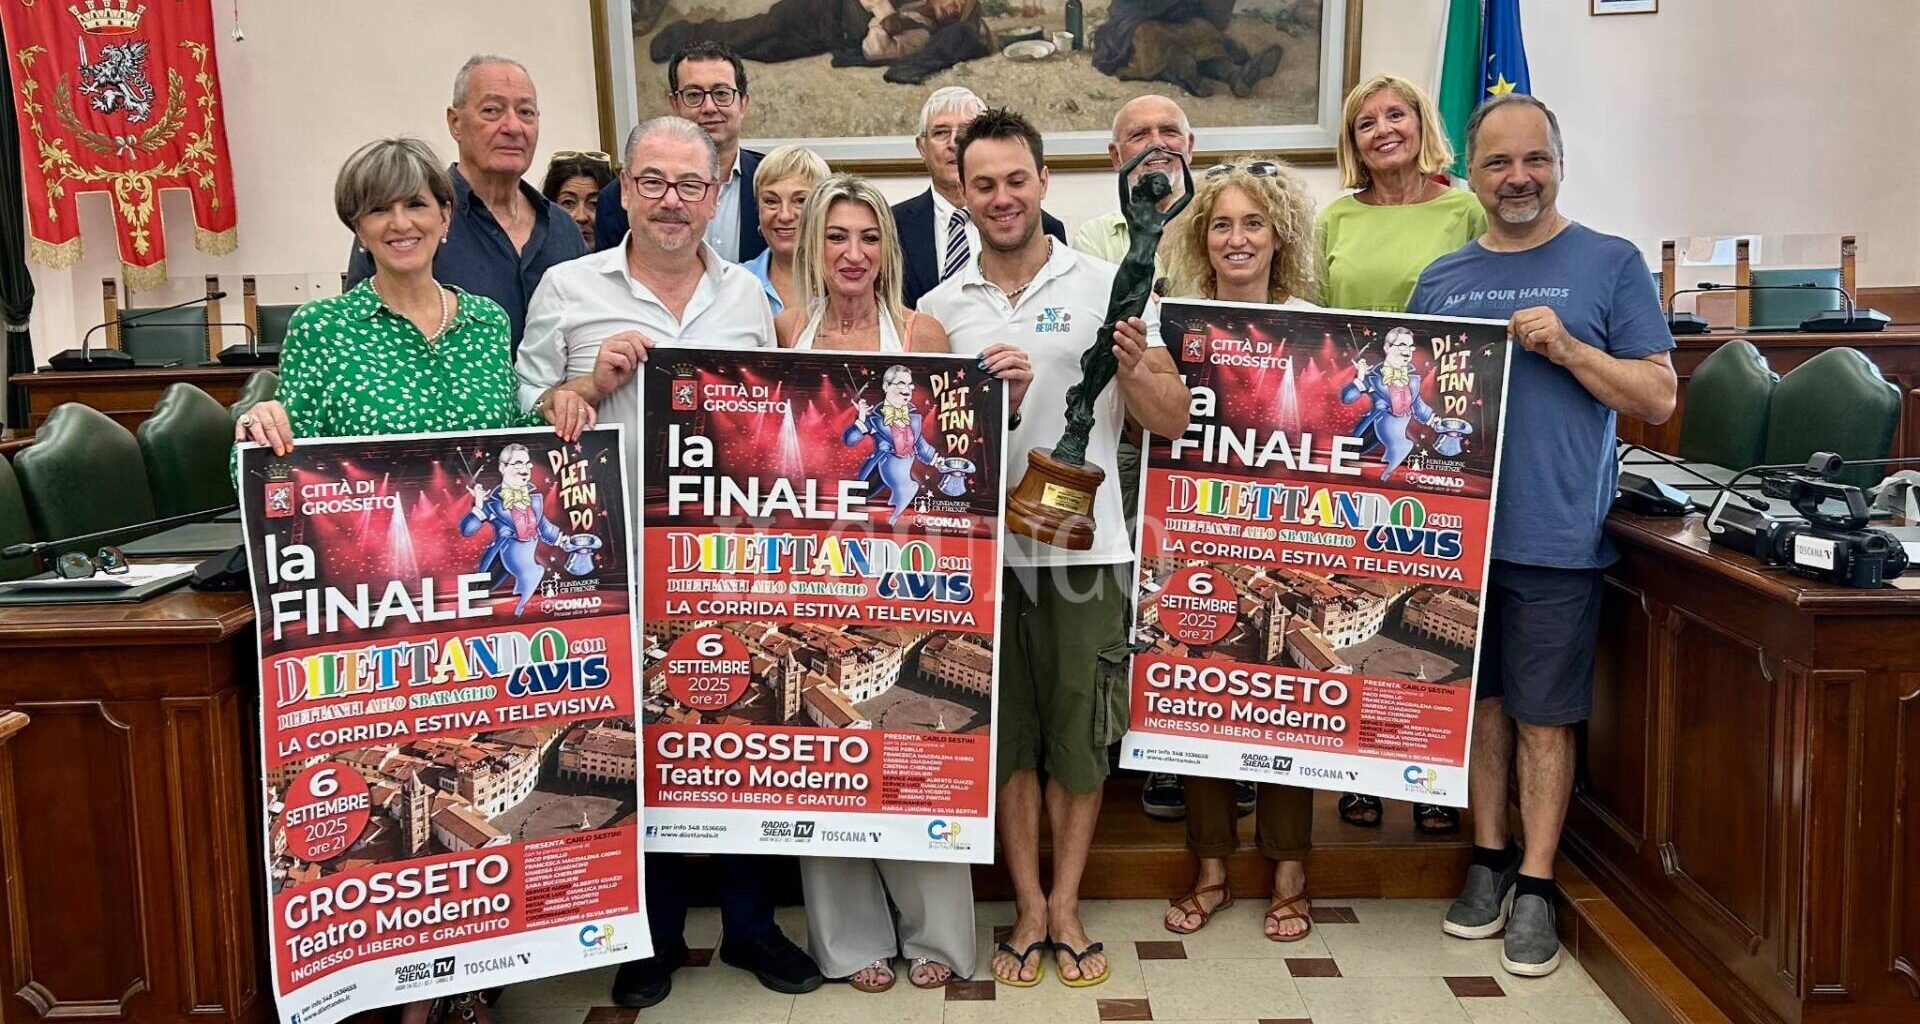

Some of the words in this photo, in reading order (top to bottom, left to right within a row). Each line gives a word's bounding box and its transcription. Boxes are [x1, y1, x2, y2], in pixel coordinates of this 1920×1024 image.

[1469, 291, 1484, 301] IN
[1487, 289, 1516, 300] OUR
[1518, 287, 1570, 299] HANDS
[1035, 323, 1070, 333] BETAFLAG
[1211, 339, 1253, 352] CITTÀ
[1256, 342, 1272, 354] DI
[1431, 335, 1451, 360] DI
[1210, 353, 1289, 370] GROSSETO
[1440, 350, 1470, 374] LET
[703, 383, 748, 397] CITTÀ
[752, 386, 768, 398] DI
[930, 371, 949, 398] DI
[1438, 372, 1474, 392] TAN
[704, 399, 787, 414] GROSSETO
[941, 387, 969, 412] LET
[1444, 395, 1467, 415] DO
[938, 410, 974, 431] TAN
[669, 424, 713, 468] la
[946, 434, 969, 454] DO
[1171, 424, 1362, 475] FINALE
[548, 446, 568, 474] DI
[561, 460, 588, 489] LET
[1418, 475, 1465, 487] CONAD
[301, 479, 352, 499] CITTÀ
[356, 480, 375, 494] DI
[560, 483, 596, 509] TAN
[669, 475, 869, 520] FINALE
[302, 496, 396, 515] GROSSETO
[1168, 476, 1426, 530] DILETTANDO
[1427, 513, 1463, 528] con
[569, 508, 593, 530] DO
[925, 517, 971, 528] CONAD
[1364, 523, 1462, 559] AVIS
[265, 535, 315, 583] la
[668, 533, 935, 578] DILETTANDO
[937, 556, 972, 571] con
[1162, 539, 1185, 552] LA
[1190, 541, 1275, 561] CORRIDA
[1281, 549, 1347, 568] ESTIVA
[1353, 556, 1462, 580] TELEVISIVA
[877, 570, 973, 603] AVIS
[1188, 572, 1213, 594] 6
[271, 573, 492, 639] FINALE
[554, 597, 602, 610] CONAD
[666, 600, 691, 614] LA
[696, 600, 787, 615] CORRIDA
[793, 603, 860, 618] ESTIVA
[866, 605, 975, 625] TELEVISIVA
[1161, 594, 1237, 614] SETTEMBRE
[1178, 612, 1217, 628] 2025
[697, 634, 723, 656] 6
[1179, 629, 1200, 639] ore
[1202, 629, 1214, 640] 21
[276, 629, 568, 706] DILETTANDO
[570, 637, 608, 654] con
[507, 654, 610, 697] AVIS
[669, 660, 749, 674] SETTEMBRE
[688, 677, 730, 691] 2025
[1147, 662, 1347, 705] GROSSETO
[690, 695, 712, 704] ore
[715, 693, 727, 705] 21
[1144, 692, 1223, 718] Teatro
[1231, 700, 1345, 731] Moderno
[278, 737, 302, 757] LA
[306, 720, 408, 748] CORRIDA
[415, 710, 490, 733] ESTIVA
[496, 695, 614, 722] TELEVISIVA
[1144, 717, 1209, 733] INGRESSO
[1213, 725, 1261, 738] LIBERO
[1265, 730, 1273, 740] E
[1276, 731, 1344, 747] GRATUITO
[658, 732, 868, 763] GROSSETO
[1241, 753, 1268, 762] RADIO
[1243, 759, 1270, 769] SIENA
[1276, 759, 1291, 768] TV
[1300, 766, 1345, 780] TOSCANA
[310, 769, 338, 797] 6
[656, 764, 741, 786] Teatro
[750, 765, 868, 790] Moderno
[659, 791, 728, 802] INGRESSO
[732, 792, 782, 804] LIBERO
[786, 794, 794, 804] E
[798, 794, 867, 806] GRATUITO
[286, 793, 369, 827] SETTEMBRE
[304, 816, 348, 842] 2025
[761, 821, 789, 829] RADIO
[763, 828, 791, 837] SIENA
[797, 824, 813, 835] TV
[822, 830, 866, 842] TOSCANA
[308, 842, 330, 857] ore
[332, 835, 345, 850] 21
[284, 855, 508, 928] GROSSETO
[287, 919, 367, 962] Teatro
[376, 894, 510, 933] Moderno
[291, 948, 354, 982] INGRESSO
[358, 935, 415, 956] LIBERO
[420, 932, 428, 944] E
[433, 917, 509, 941] GRATUITO
[395, 962, 427, 976] RADIO
[398, 970, 430, 984] SIENA
[436, 960, 453, 974] TV
[465, 956, 515, 976] TOSCANA
